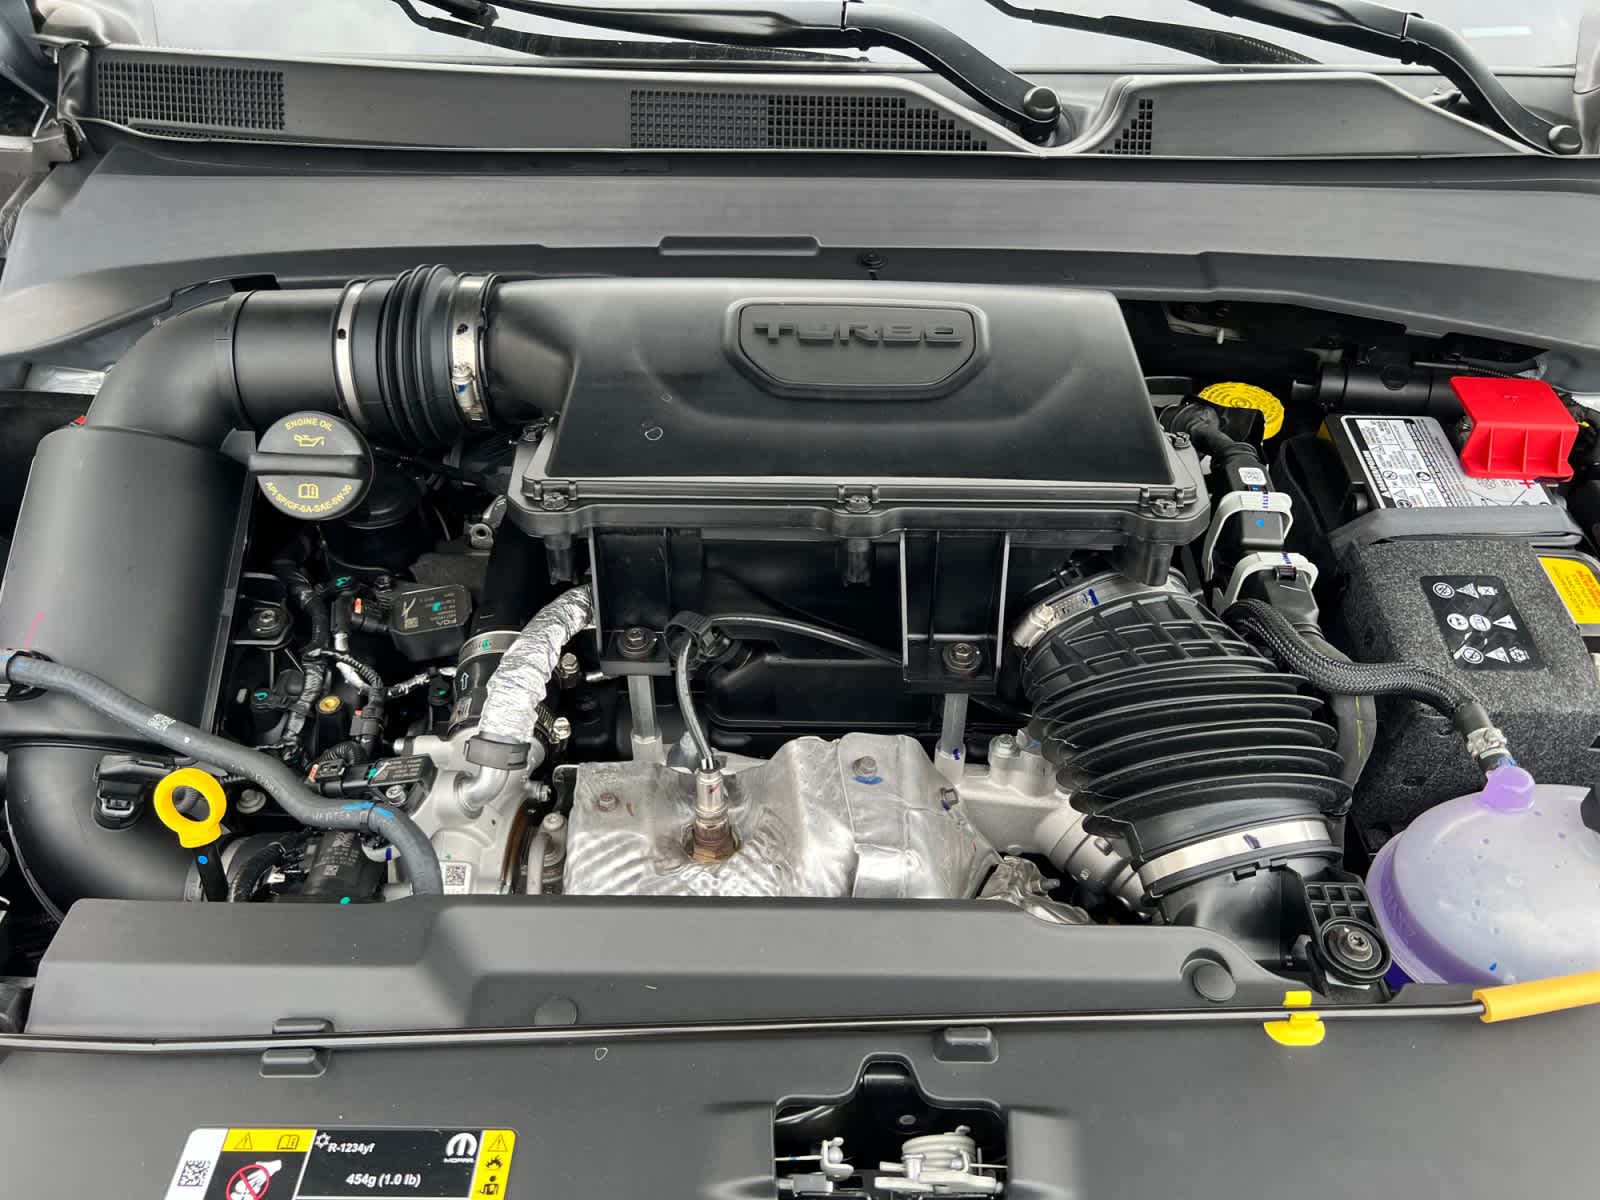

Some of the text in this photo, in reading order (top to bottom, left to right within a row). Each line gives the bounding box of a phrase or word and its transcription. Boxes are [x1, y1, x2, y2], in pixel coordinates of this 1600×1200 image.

[753, 320, 963, 346] TURBO
[285, 417, 333, 431] ENGINE OIL
[327, 1142, 376, 1155] R-1234yf
[345, 1173, 421, 1188] 454g (1.0 lb)
